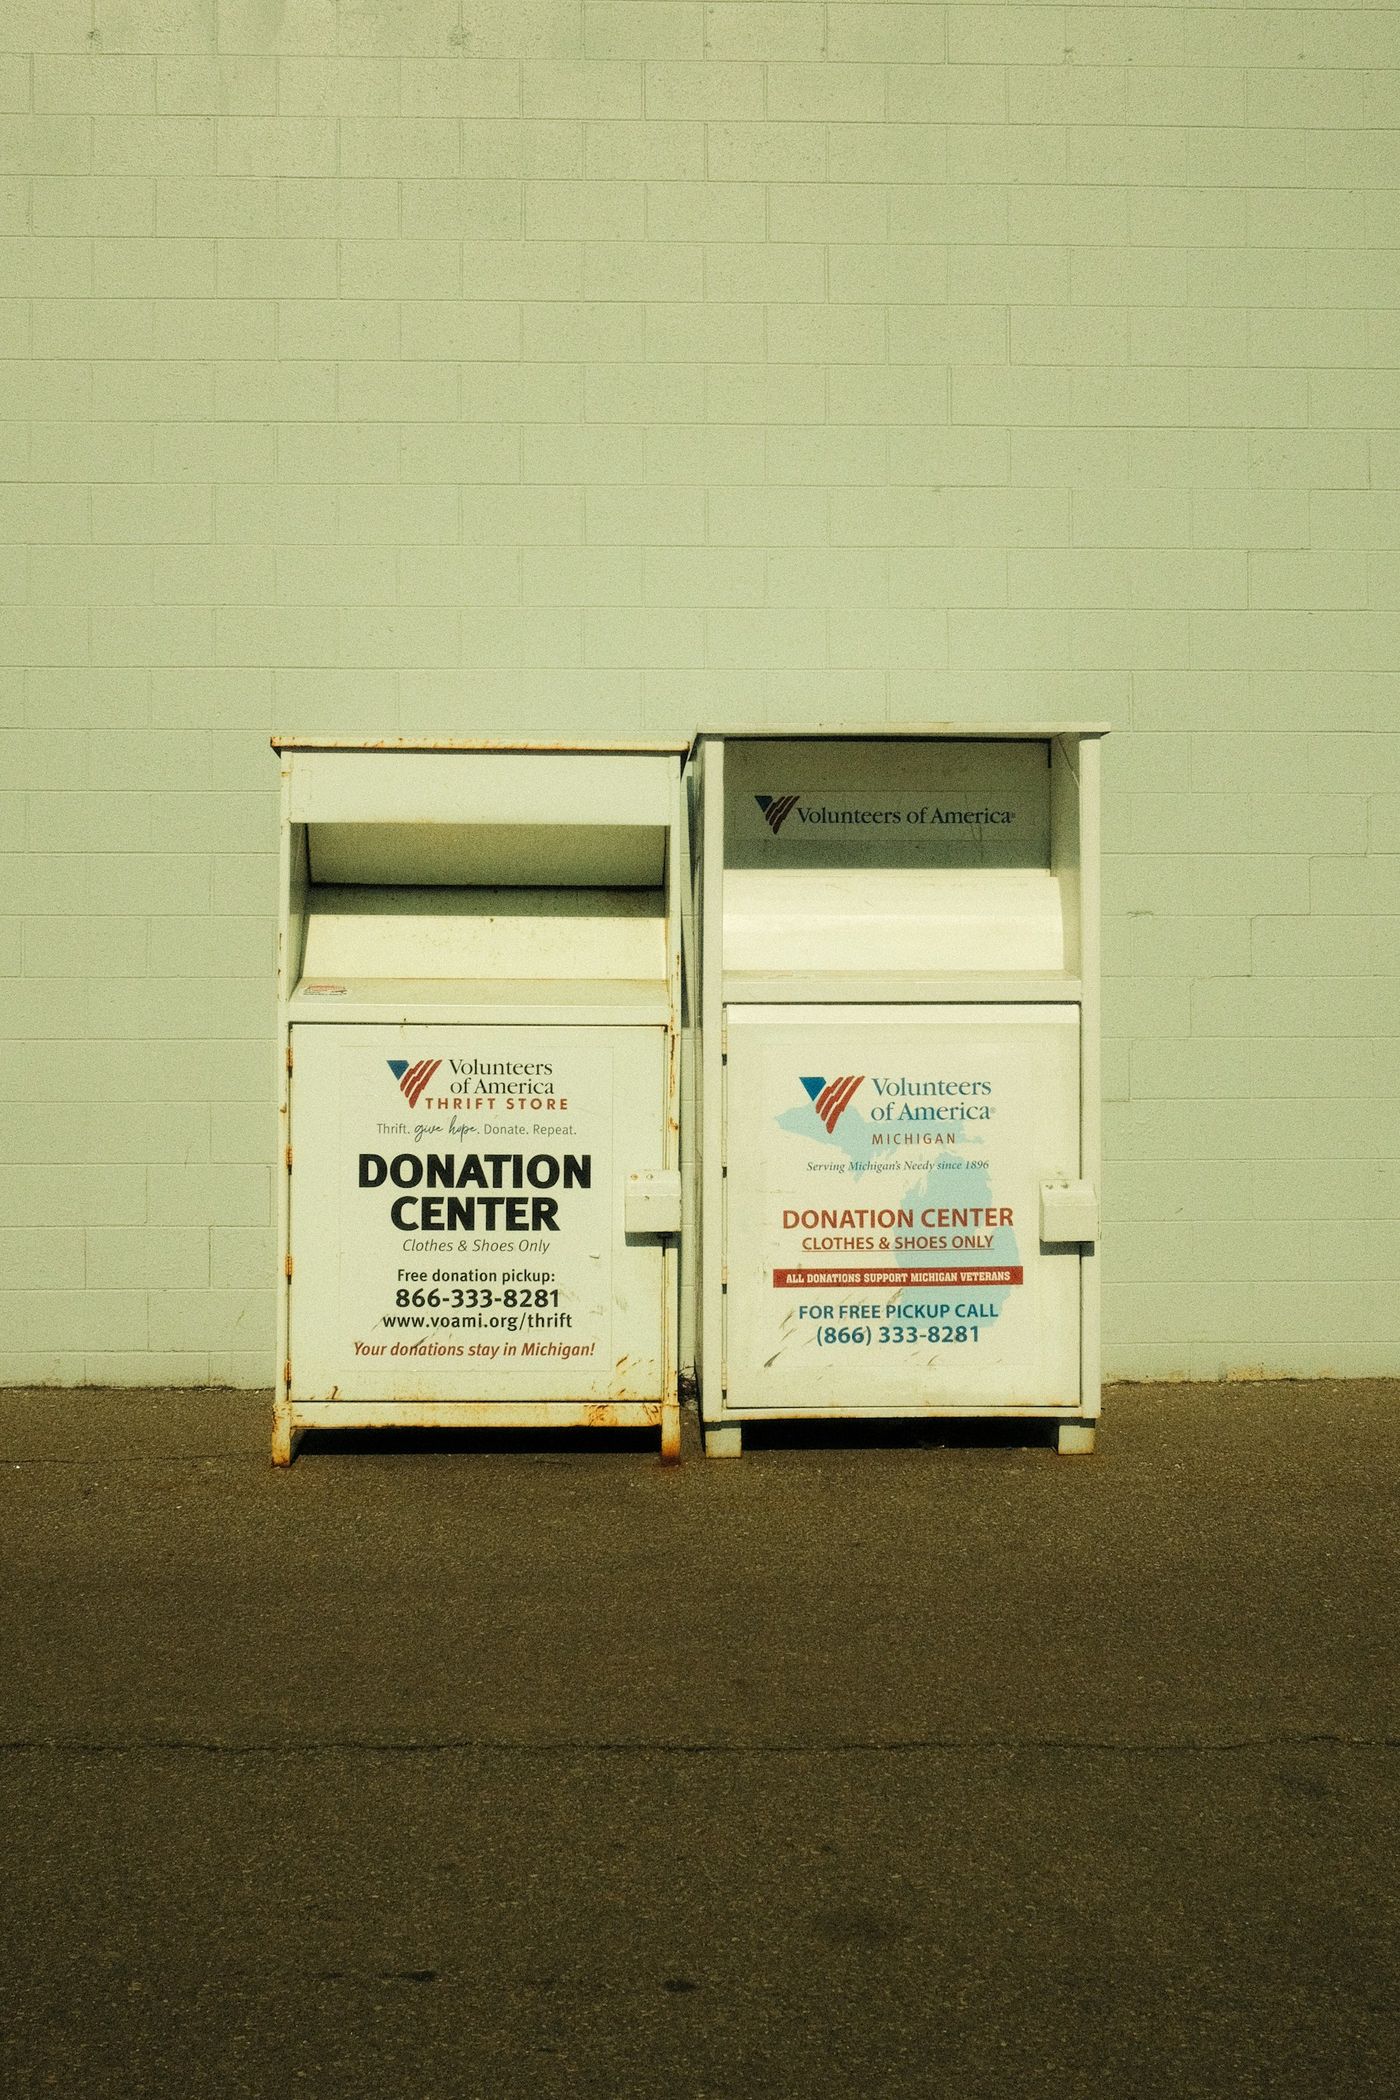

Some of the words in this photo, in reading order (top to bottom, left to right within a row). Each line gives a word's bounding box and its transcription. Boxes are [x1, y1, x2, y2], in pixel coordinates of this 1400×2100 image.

[797, 807, 901, 824] Volunteers
[907, 807, 928, 824] of
[449, 1059, 553, 1076] Volunteers
[450, 1078, 472, 1094] of
[474, 1078, 554, 1095] America
[872, 1077, 992, 1096] Volunteers
[425, 1098, 496, 1110] THRIFT
[506, 1098, 568, 1110] STORE
[871, 1102, 894, 1120] of
[377, 1123, 410, 1134] Thrift.
[414, 1123, 443, 1143] give
[484, 1124, 529, 1135] Donate.
[533, 1124, 577, 1137] Repeat.
[872, 1133, 956, 1145] MICHIGAN
[359, 1153, 591, 1189] DONATION
[807, 1161, 845, 1173] Serving
[904, 1160, 935, 1172] Needy
[937, 1161, 962, 1170] since
[965, 1160, 990, 1170] 1896
[390, 1196, 561, 1231] CENTER
[783, 1209, 914, 1229] DONATION
[921, 1207, 1014, 1228] CENTER
[402, 1239, 453, 1252] Clothes
[458, 1240, 467, 1252] &
[472, 1239, 514, 1252] Shoes
[518, 1239, 550, 1254] Only
[802, 1236, 874, 1250] CLOTHES
[879, 1237, 890, 1250] &
[894, 1236, 947, 1250] SHOES
[952, 1235, 994, 1249] ONLY
[398, 1269, 428, 1282] Free
[432, 1269, 497, 1282] donation
[502, 1269, 555, 1285] pickup:
[786, 1273, 804, 1284] ALL
[807, 1273, 861, 1283] DONATIONS
[864, 1272, 908, 1283] SUPPORT
[910, 1272, 957, 1282] MICHIGAN
[960, 1271, 1011, 1281] VETERANS
[395, 1288, 559, 1308] 866-333-8281
[799, 1305, 834, 1320] FOR
[839, 1305, 881, 1319] FREE
[886, 1304, 950, 1318] PICKUP
[955, 1303, 998, 1318] CALL
[383, 1313, 572, 1331] www.voami.org/thrift
[817, 1326, 872, 1346] (866)
[878, 1325, 979, 1343] 333-8281
[353, 1342, 386, 1356] Your
[390, 1342, 464, 1356] donations
[468, 1343, 499, 1359] stay
[503, 1343, 517, 1356] in
[521, 1342, 596, 1359] Michigan!
